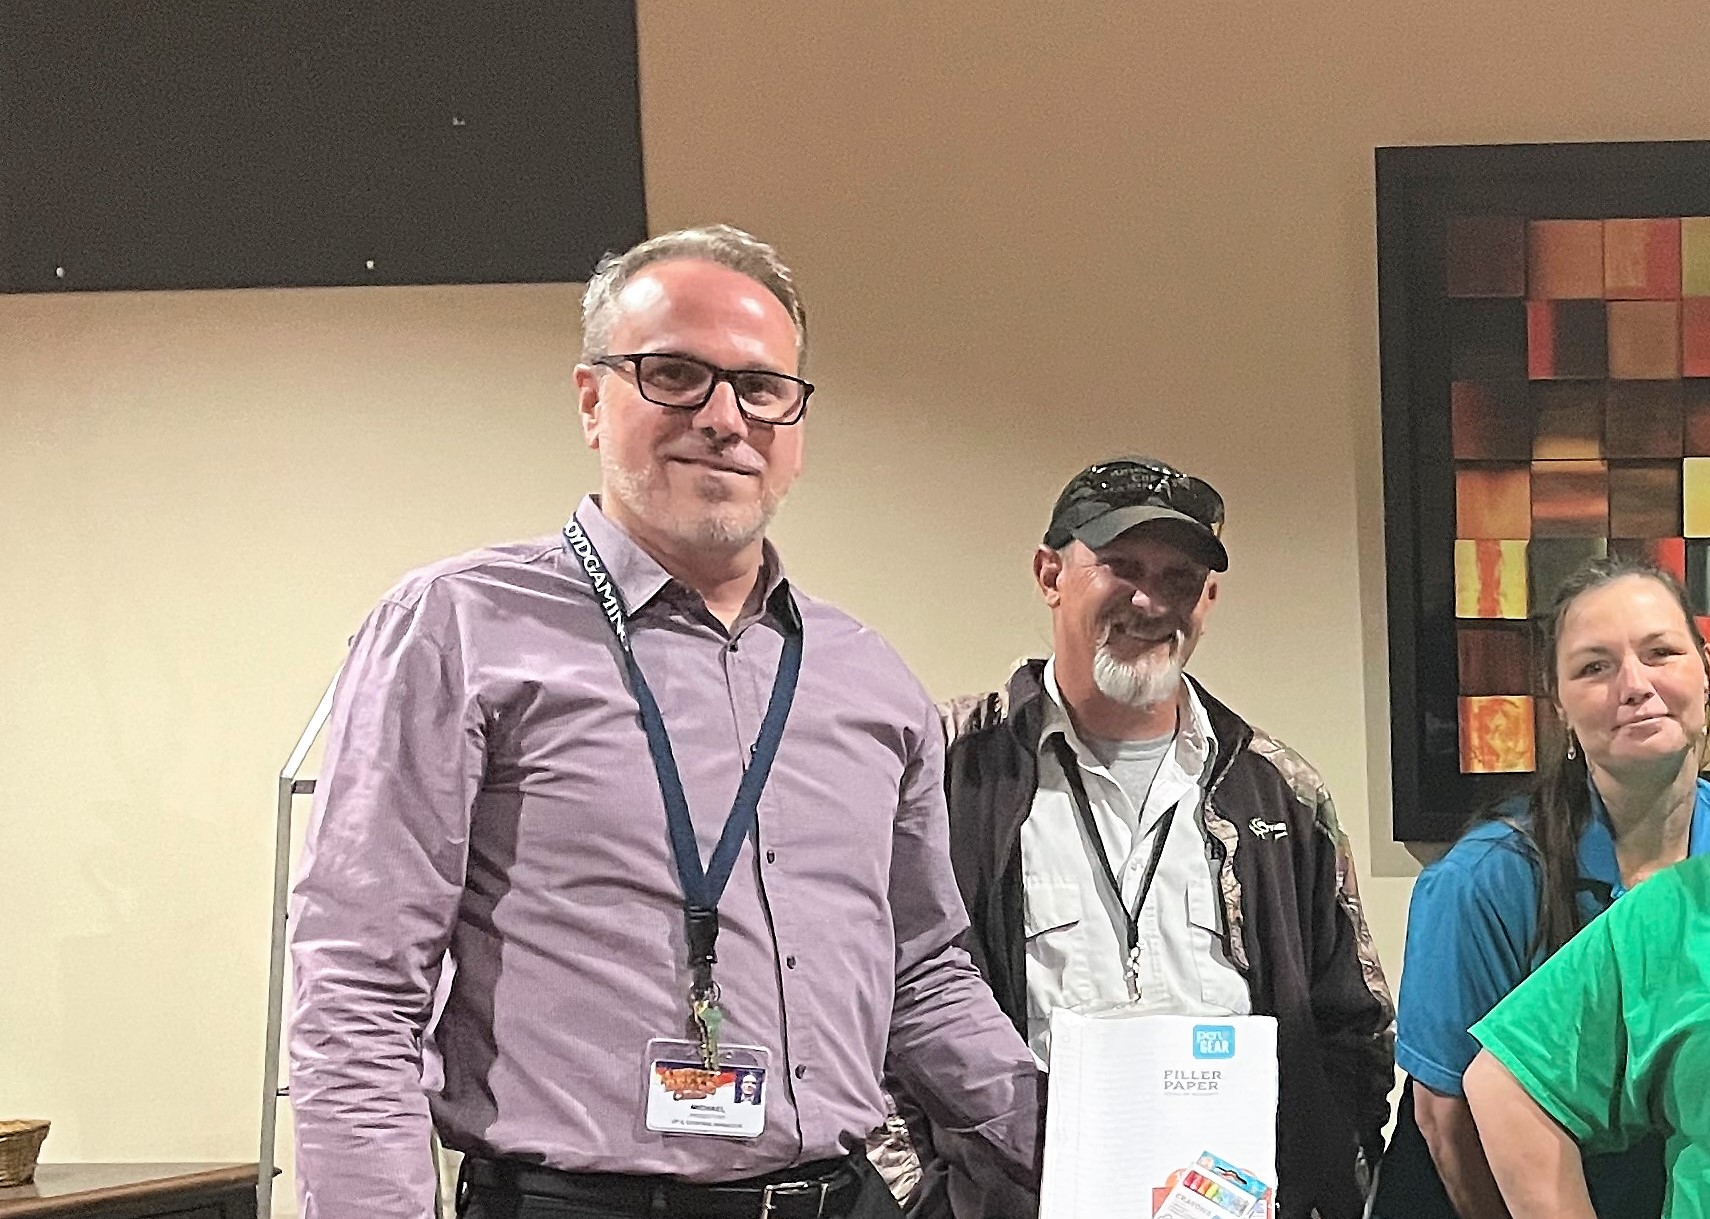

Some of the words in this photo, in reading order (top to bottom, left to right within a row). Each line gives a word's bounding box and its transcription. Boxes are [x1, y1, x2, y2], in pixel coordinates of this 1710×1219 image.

[565, 519, 629, 651] OYDGAMIN
[1163, 1070, 1222, 1080] FILLER
[1163, 1080, 1219, 1091] PAPER
